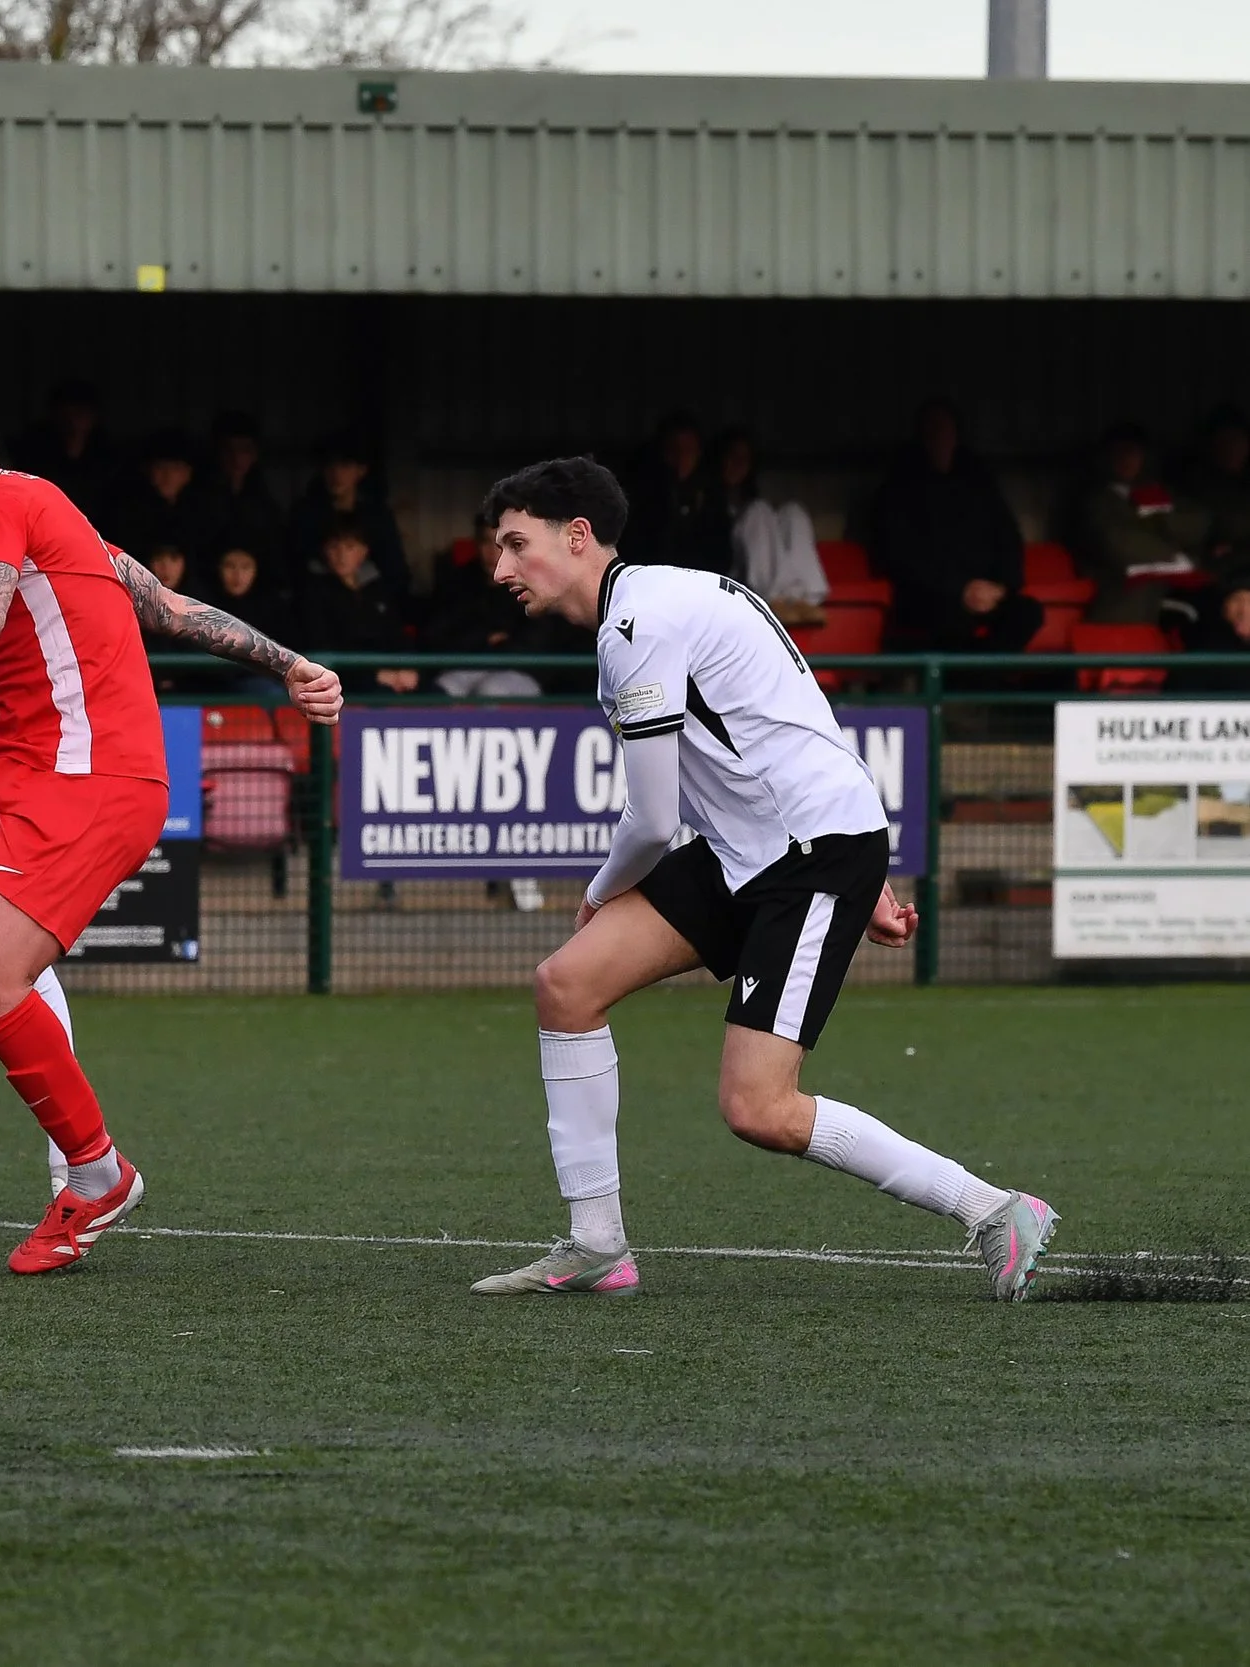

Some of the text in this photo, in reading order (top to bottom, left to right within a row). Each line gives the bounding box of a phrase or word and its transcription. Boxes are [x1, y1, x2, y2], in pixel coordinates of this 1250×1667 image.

[1097, 718, 1190, 741] HULME
[361, 727, 557, 813] NEWBY
[361, 823, 491, 854] CHARTERED
